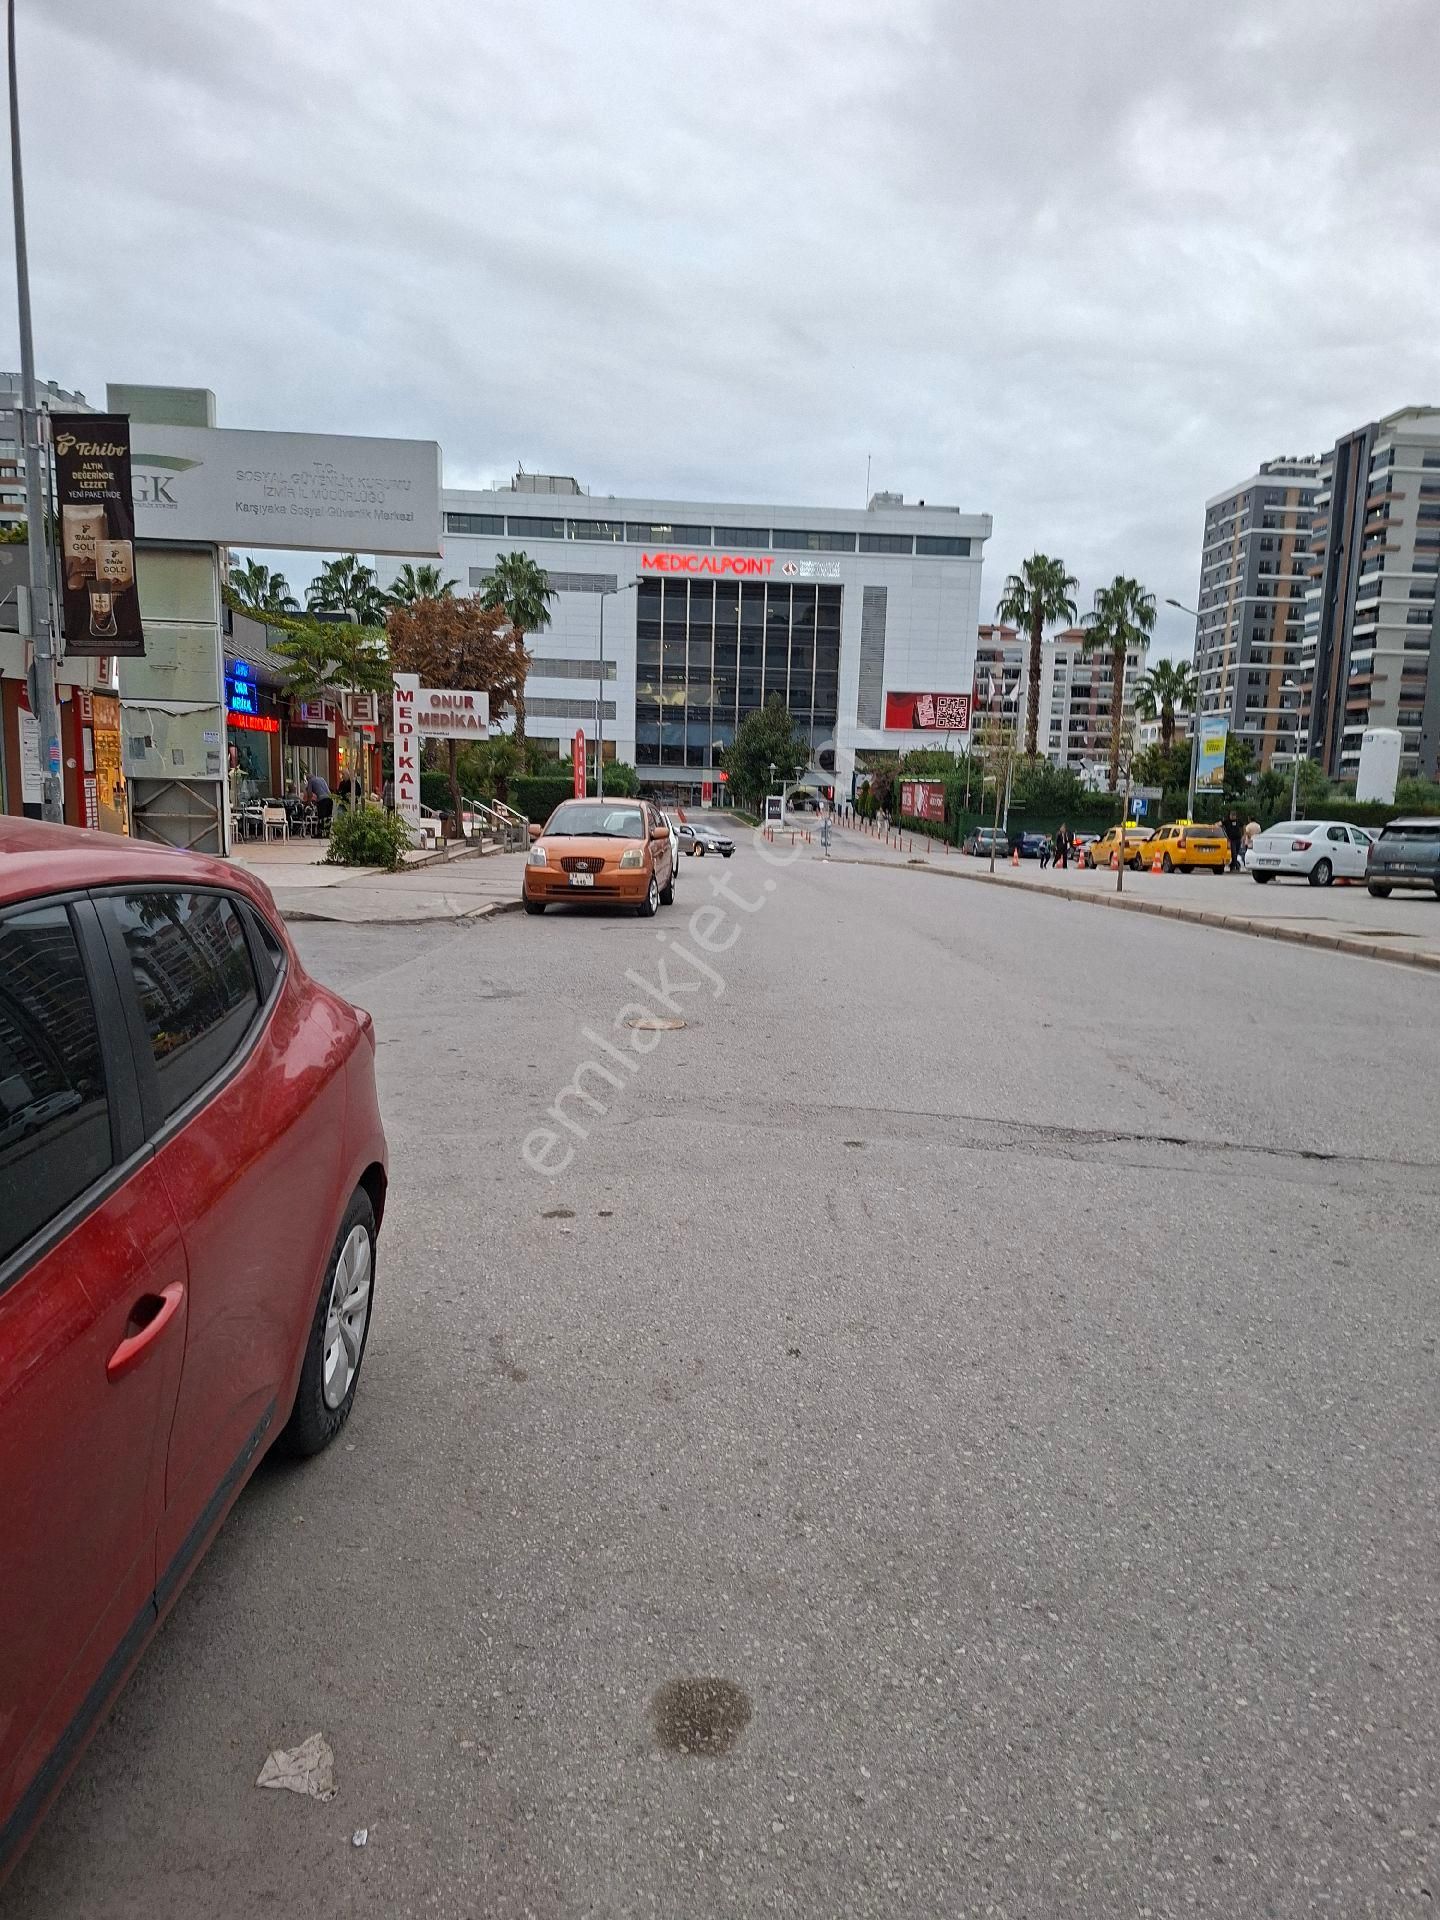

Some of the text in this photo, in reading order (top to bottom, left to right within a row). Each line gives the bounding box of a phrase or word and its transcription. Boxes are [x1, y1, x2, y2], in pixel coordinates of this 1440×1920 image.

[76, 442, 128, 457] Tchibo
[82, 462, 104, 470] ALTIN
[71, 470, 115, 480] DEĞERİNDE
[80, 481, 107, 489] LEZZET
[235, 501, 286, 516] Karşıyaka
[641, 552, 775, 576] MEDICALPOINT
[429, 694, 475, 710] ONUR
[417, 711, 487, 729] MEDİKAL
[396, 690, 414, 800] MEDİKAL
